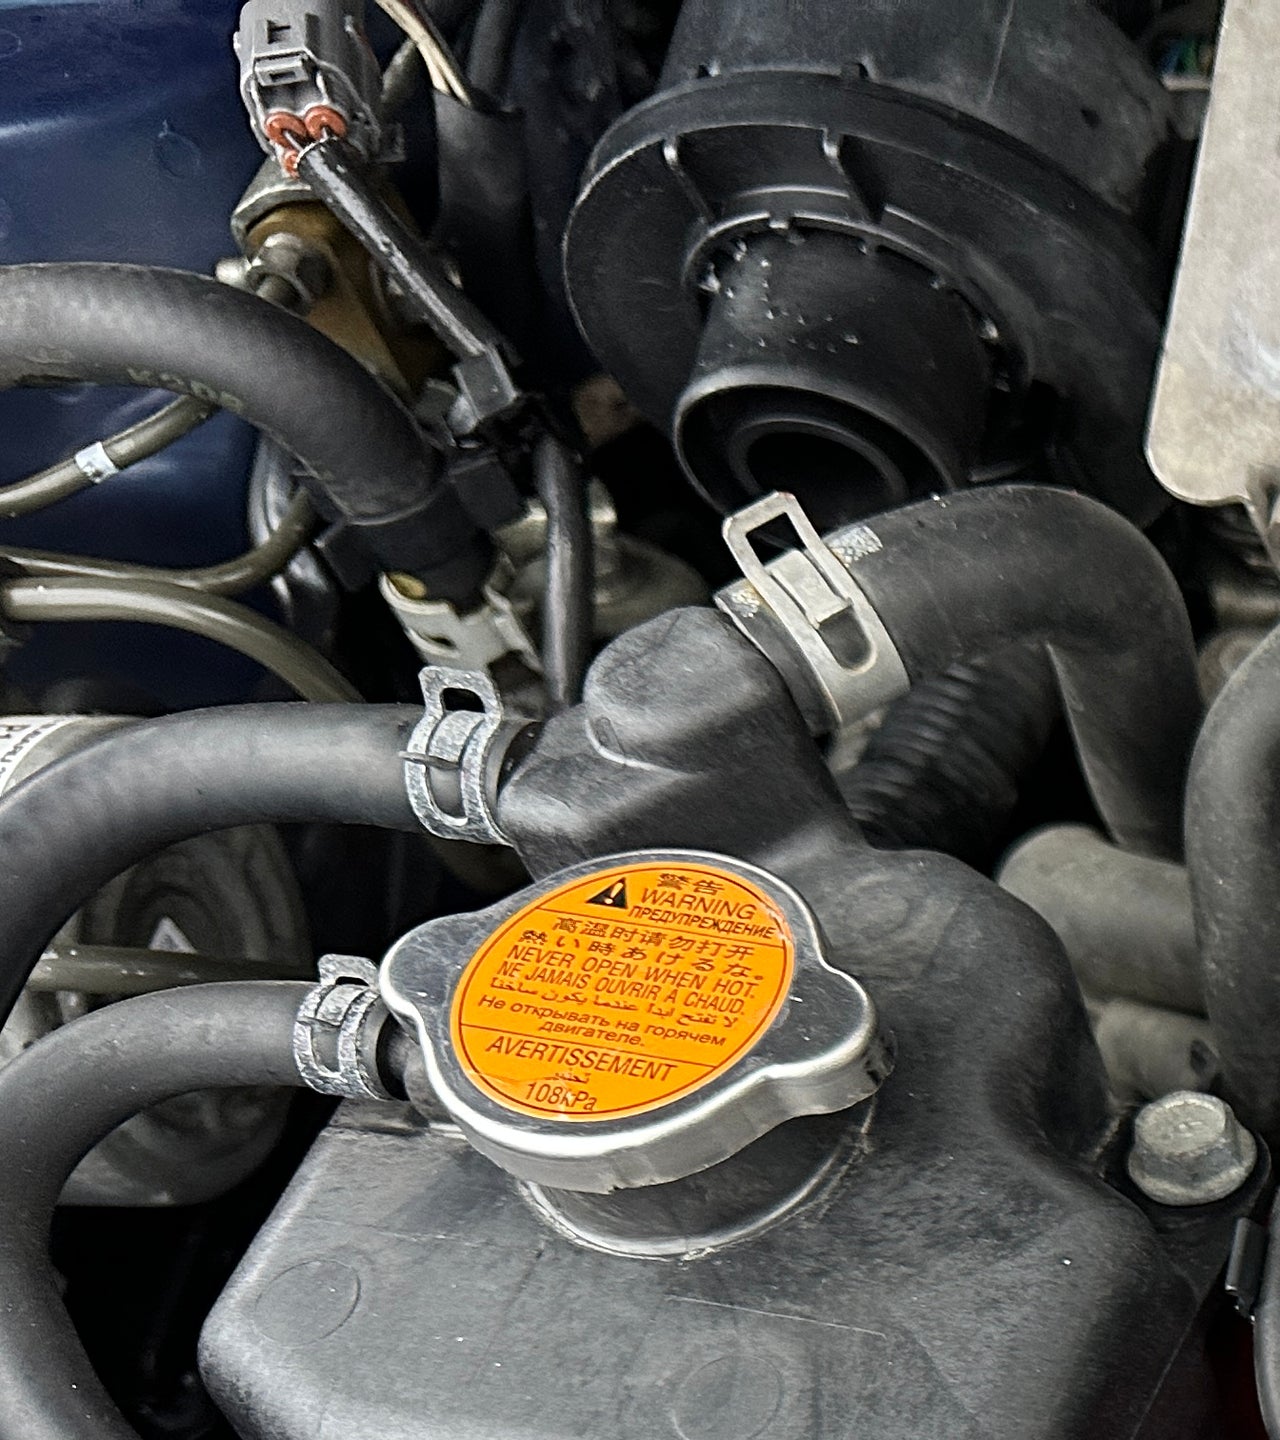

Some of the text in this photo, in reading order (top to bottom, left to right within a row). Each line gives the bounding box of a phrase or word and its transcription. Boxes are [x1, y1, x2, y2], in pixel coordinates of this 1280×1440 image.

[656, 872, 727, 896] 警告
[640, 888, 757, 920] WARNING
[628, 905, 777, 940] ПРЕДУПРЕЖДЕНИЕ
[497, 961, 525, 977] NE
[524, 968, 592, 989] JAMAIS
[594, 977, 662, 1001] OUVRIR
[683, 991, 745, 1015] CHAUD.
[507, 944, 759, 998] NEVER OPEN WHEN HOT.
[478, 994, 727, 1046] Не открывать на горячем
[538, 1021, 645, 1047] двигателе.
[486, 1035, 678, 1082] AVERTISSEMENT
[526, 1081, 599, 1112] 108kPa
